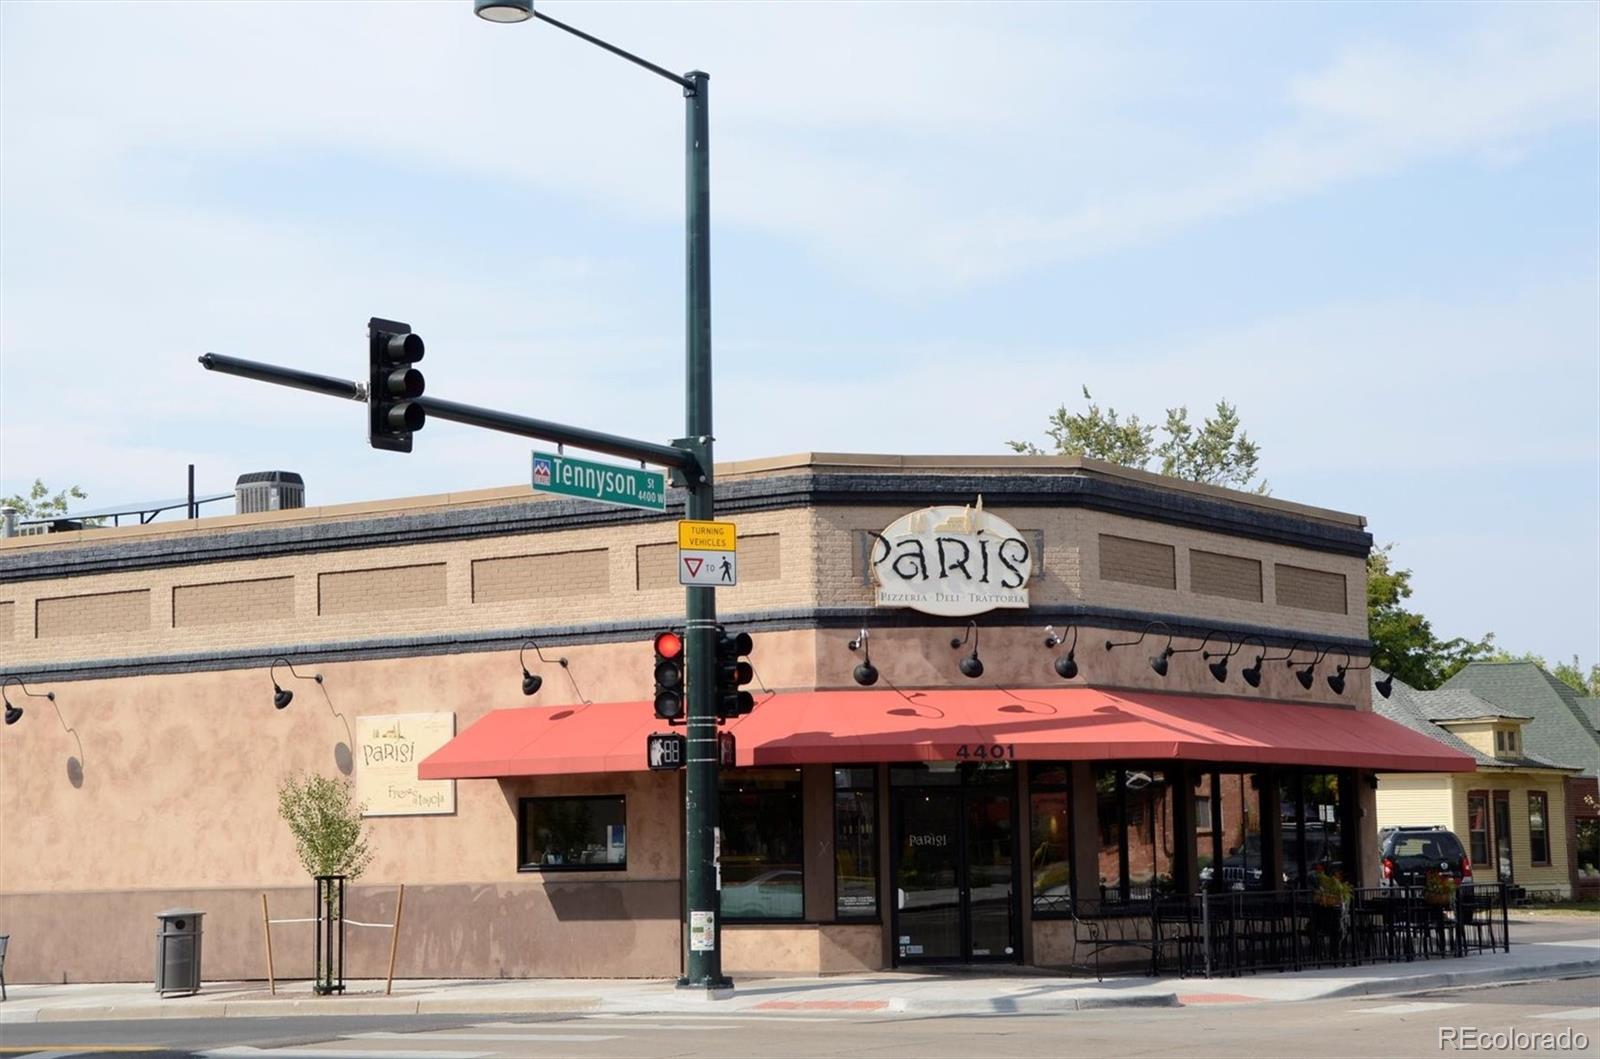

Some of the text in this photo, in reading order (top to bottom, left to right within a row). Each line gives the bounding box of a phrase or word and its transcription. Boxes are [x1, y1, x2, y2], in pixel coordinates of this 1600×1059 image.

[554, 458, 655, 497] Tennyson St
[637, 490, 656, 503] 4400
[691, 526, 725, 536] TURNING
[689, 538, 727, 547] VEHICLES
[705, 564, 716, 573] TO
[956, 744, 1015, 760] 4401
